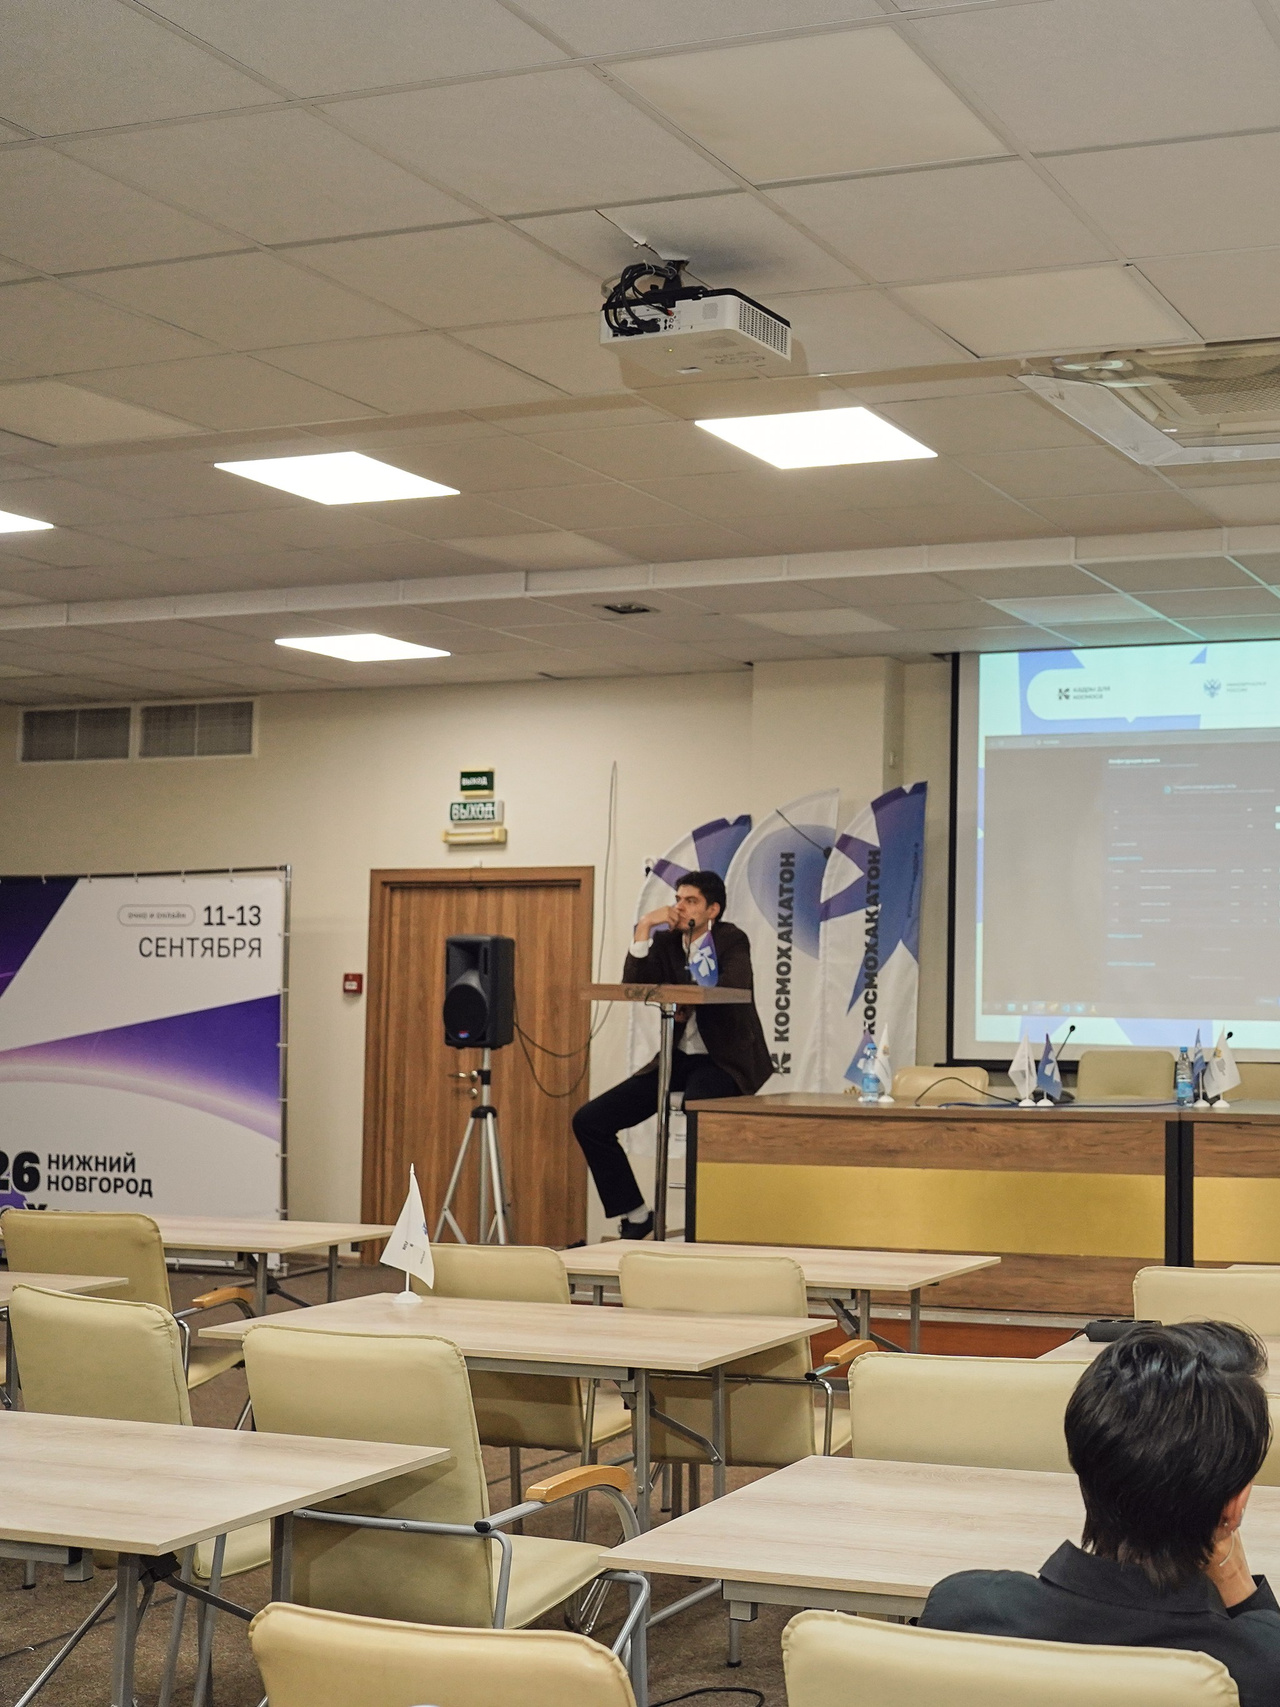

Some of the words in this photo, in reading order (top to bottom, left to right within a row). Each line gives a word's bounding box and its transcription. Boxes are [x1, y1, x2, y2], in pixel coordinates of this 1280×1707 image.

[451, 803, 494, 820] ВЫХОД
[203, 905, 262, 926] 11-13
[139, 936, 262, 958] СЕНТЯБРЯ
[774, 851, 796, 1042] КОСМОХАКАТОН
[863, 850, 881, 1035] КОСМОХАКАТОН
[47, 1152, 136, 1173] НИЖНИЙ
[47, 1174, 153, 1198] НОВГОРОД
